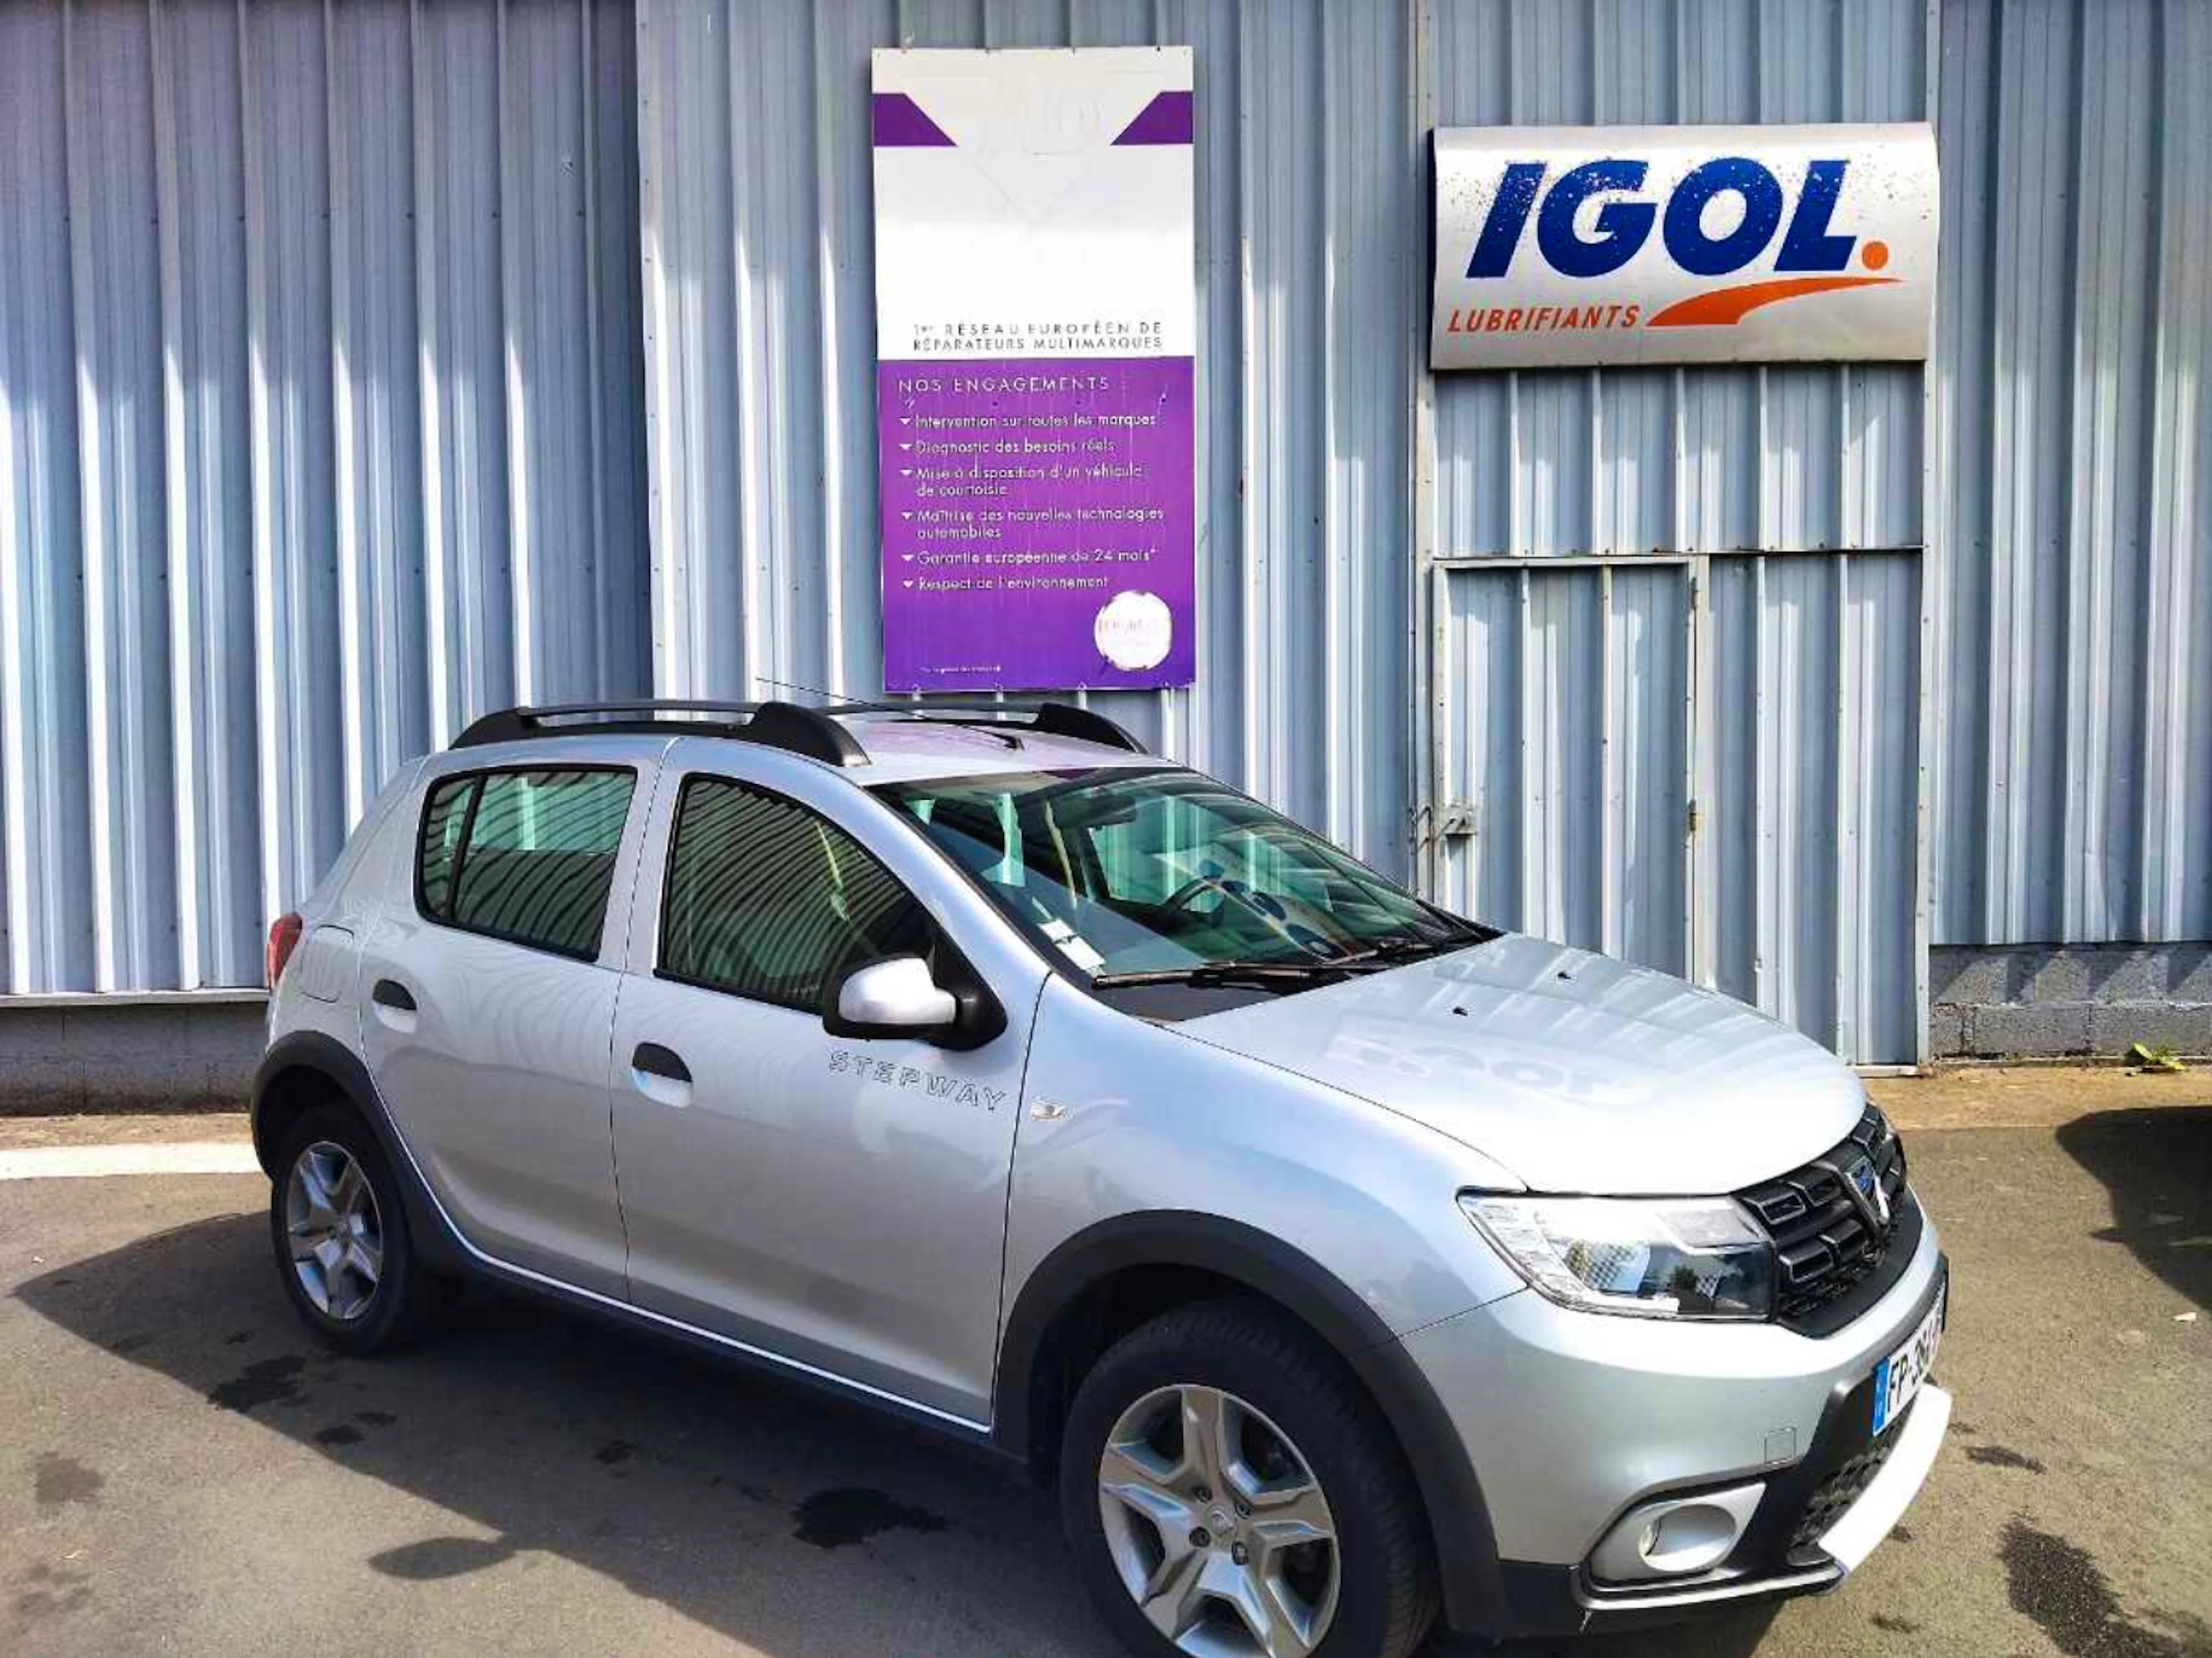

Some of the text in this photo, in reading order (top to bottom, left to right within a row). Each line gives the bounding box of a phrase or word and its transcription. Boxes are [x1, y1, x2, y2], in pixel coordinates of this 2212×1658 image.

[1448, 305, 1640, 332] LUBRIFIANTS
[945, 320, 1018, 336] RÉSEAU
[1028, 319, 1129, 335] EUROPÉEN
[1140, 321, 1161, 334] DE
[914, 336, 1162, 351] RÉPARATEURS MULTIMARQUES
[899, 376, 1109, 395] NOS ENGAGEMENTS
[916, 412, 1156, 428] Intervention sur toutes les marques
[916, 440, 990, 456] Diagnostic
[995, 437, 1019, 453] des
[1024, 435, 1075, 453] besoins
[916, 467, 950, 480] Mise
[969, 464, 1045, 482] disposition
[1085, 461, 1143, 478] véhicule
[916, 483, 934, 497] de
[980, 508, 1003, 521] des
[1008, 507, 1072, 523] nouvelles
[916, 523, 1002, 540] automobiles
[918, 551, 980, 565] Garantie
[985, 551, 1067, 565] européenne
[1094, 548, 1113, 562] 24
[919, 577, 971, 592] Respect
[976, 577, 993, 589] de
[829, 1050, 1007, 1113] STEPWAY
